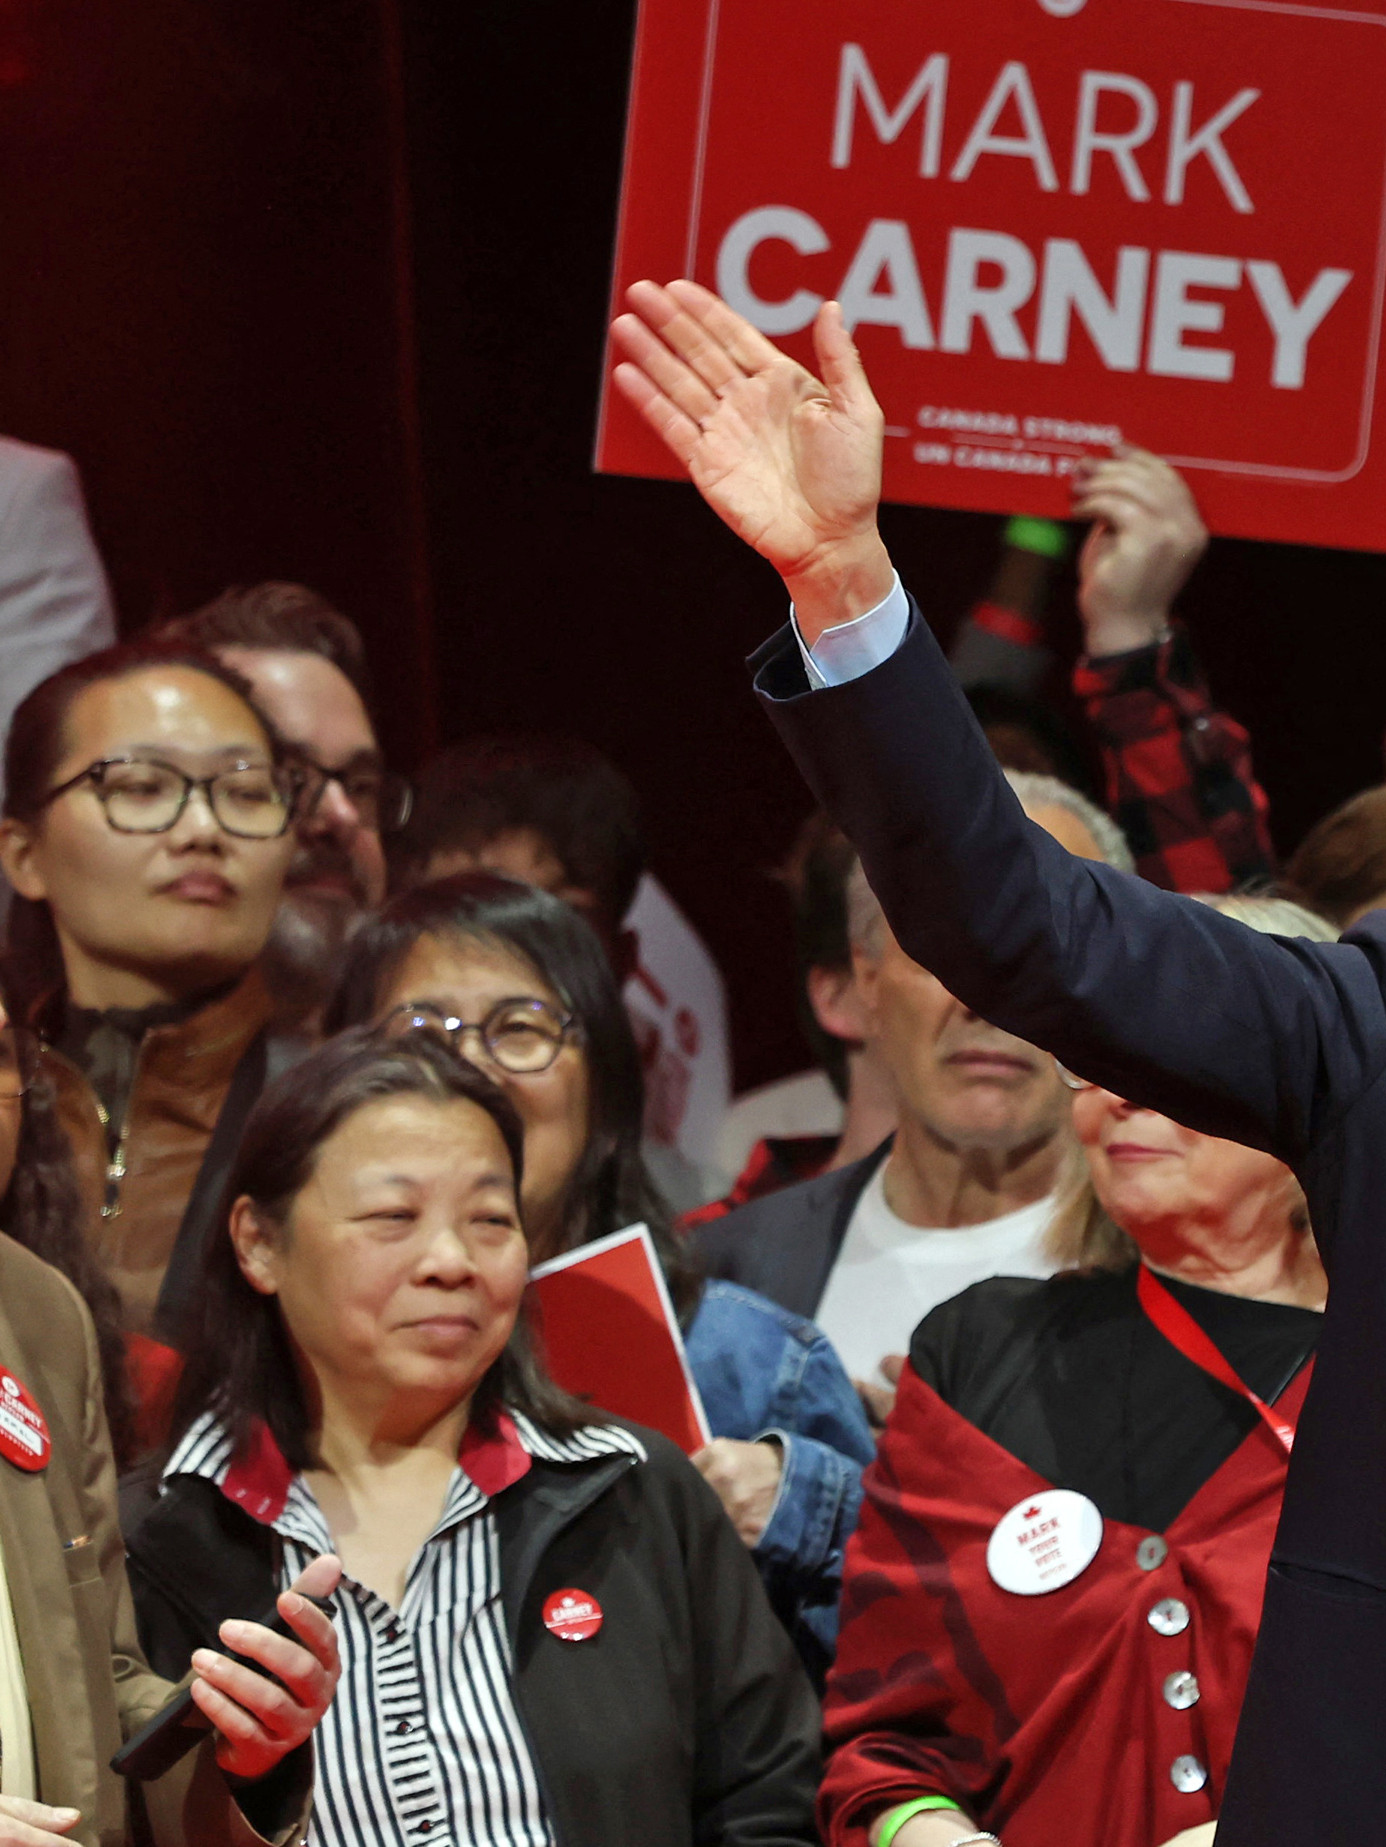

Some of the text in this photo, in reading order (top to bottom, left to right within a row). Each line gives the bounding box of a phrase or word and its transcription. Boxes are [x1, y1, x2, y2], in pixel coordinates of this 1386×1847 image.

[831, 42, 1263, 213] MARK
[716, 205, 1355, 389] CARNEY
[916, 404, 1122, 447] CANADA STRONG
[913, 442, 950, 467] UN
[952, 445, 1052, 476] CANADA
[1016, 1517, 1061, 1546] MARK
